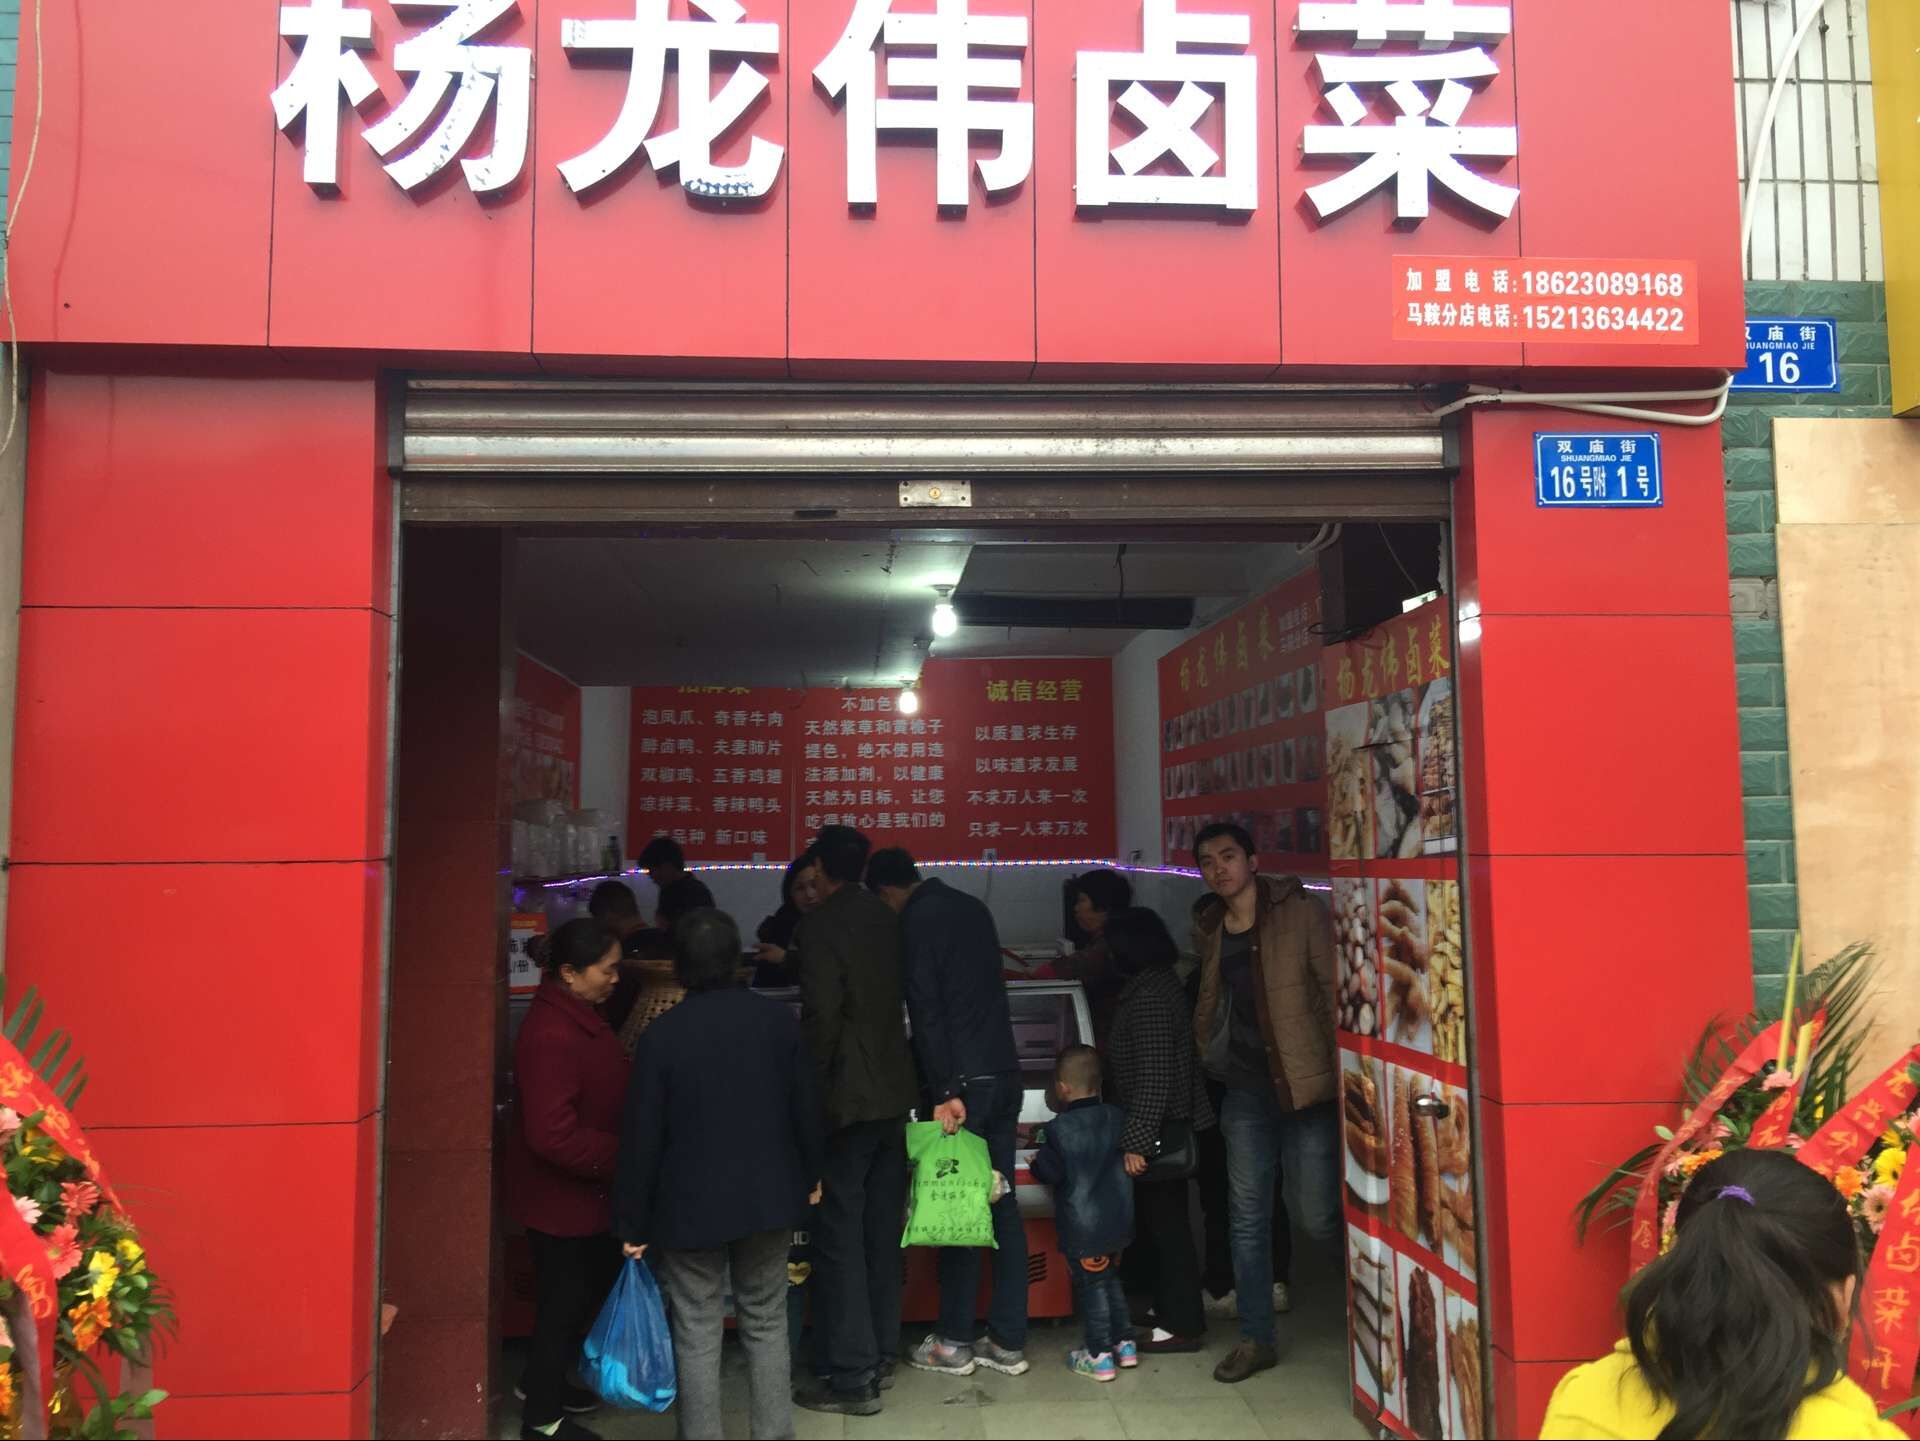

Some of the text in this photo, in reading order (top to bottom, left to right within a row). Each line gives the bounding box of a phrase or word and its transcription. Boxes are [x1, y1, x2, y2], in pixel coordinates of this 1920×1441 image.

[270, 0, 1519, 220] 杨龙伟卤菜
[1759, 351, 1801, 384] 16
[1557, 439, 1636, 454] 双庙街
[1560, 454, 1632, 463] SHUANGMIAO JIE
[986, 679, 1083, 702] 诚信经营
[841, 695, 912, 713] 不加色
[805, 719, 945, 737] 天然紫草和黄栀子
[975, 725, 1078, 742] 以质量求生存
[975, 756, 1079, 773] 以味道求发展
[967, 789, 1089, 806] 不求万人来一次
[804, 812, 945, 830] 吃得放心是我们的
[967, 821, 1089, 838] 只求一人来万次
[714, 829, 768, 845] 新口味
